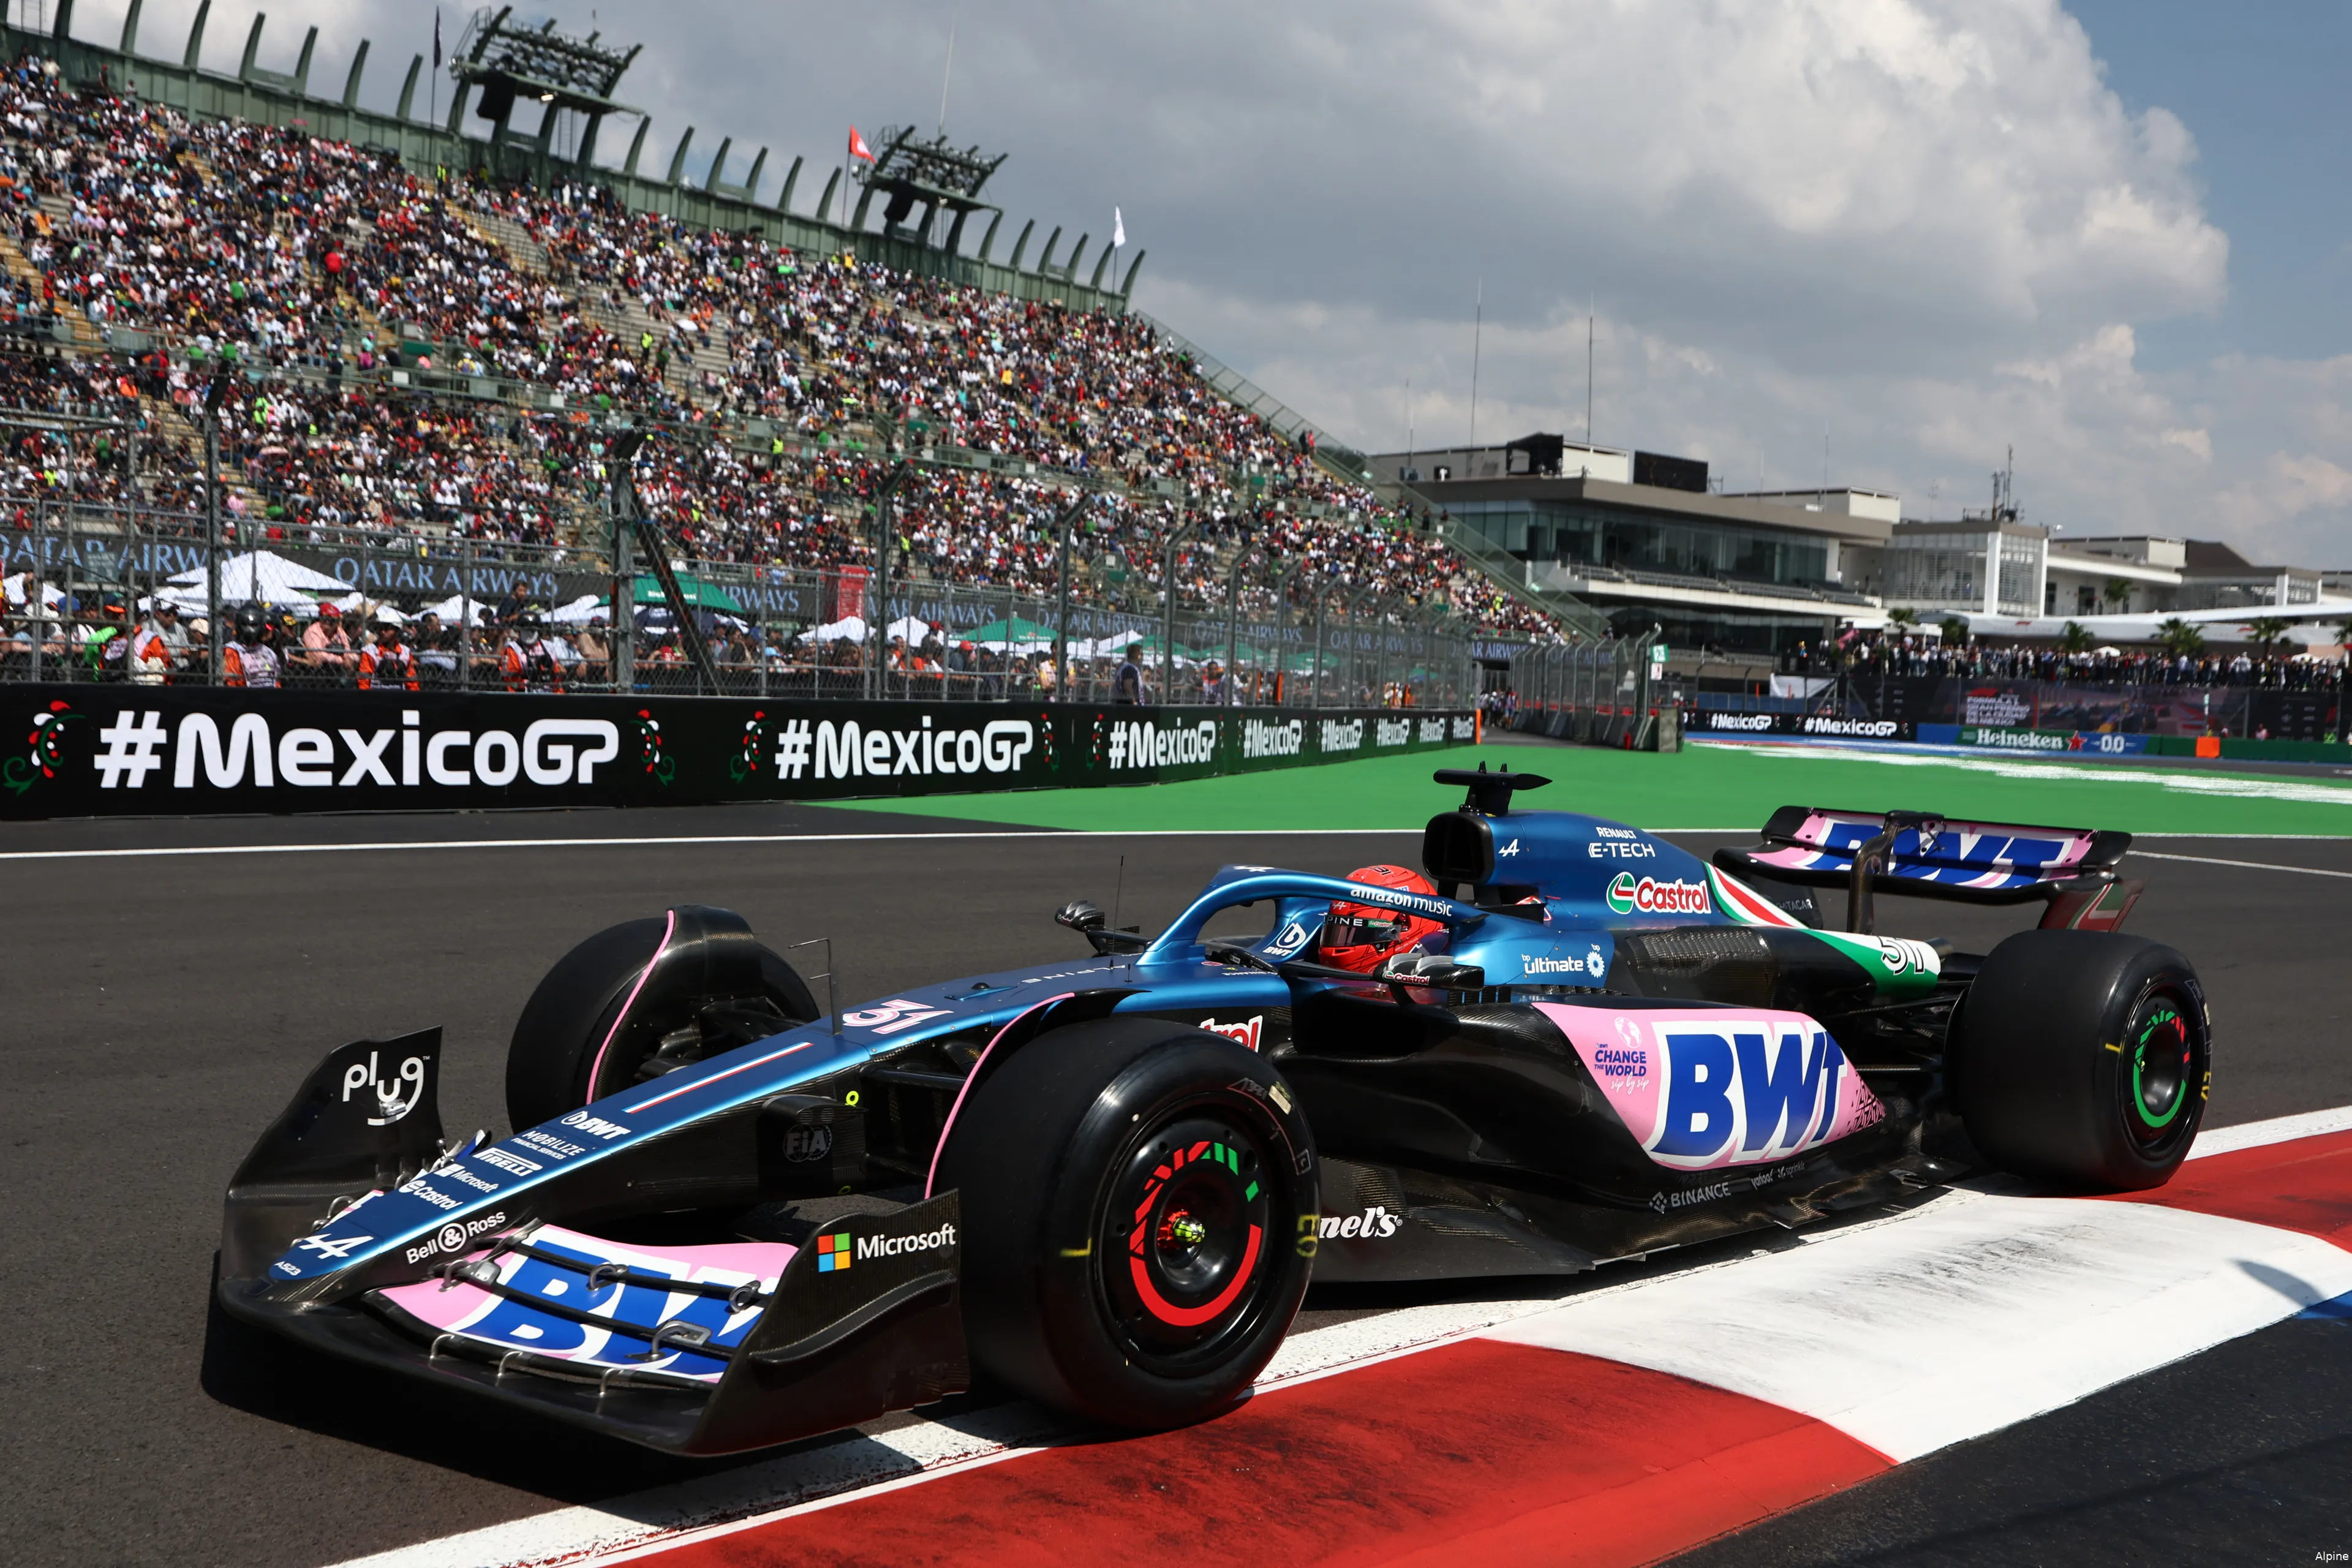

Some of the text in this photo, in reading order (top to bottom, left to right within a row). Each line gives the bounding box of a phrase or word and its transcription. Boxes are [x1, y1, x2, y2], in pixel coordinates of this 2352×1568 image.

[334, 557, 558, 597] QATAR ARWAYS
[1196, 620, 1243, 641] QATR
[1330, 630, 1371, 650] QAAR
[1376, 715, 1410, 745] #MexicoGP
[1711, 712, 1772, 730] #MexicoGP
[1804, 716, 1897, 736] #MexicoGP
[1109, 717, 1216, 769] #MexicoGP
[1243, 716, 1303, 759] #MexicoGP
[1321, 716, 1363, 752] #MexicoGP
[1977, 728, 2064, 750] Heineken
[94, 710, 619, 788] #MexicoGP
[775, 715, 1033, 779] #MexicoGP
[1596, 826, 1637, 839] RENAULT
[1588, 842, 1656, 858] E-TECH
[1350, 888, 1452, 917] amazon music
[1634, 877, 1711, 913] Castrol
[1262, 946, 1293, 956] BWT
[1525, 956, 1583, 974] ultimate
[1393, 973, 1430, 986] Castrol
[1595, 1050, 1647, 1064] CHANGE
[1605, 1065, 1647, 1077] WORLD
[1610, 1071, 1649, 1095] sip by sip
[342, 1051, 424, 1126] plug
[1648, 1022, 1846, 1166] BWT
[573, 1117, 632, 1140] BWT
[510, 1137, 567, 1160] FINANCIAL SERVICES
[473, 1147, 543, 1177] PIRELLI
[451, 1169, 499, 1193] Microsoft
[1751, 1169, 1774, 1190] yahoo!
[413, 1186, 464, 1210] Castrol
[1671, 1182, 1732, 1207] BINANCE
[1319, 1205, 1399, 1239] nel's
[406, 1238, 439, 1264] Bell
[467, 1211, 506, 1237] Ross
[857, 1223, 956, 1260] Microsoft
[274, 1261, 301, 1276] A523
